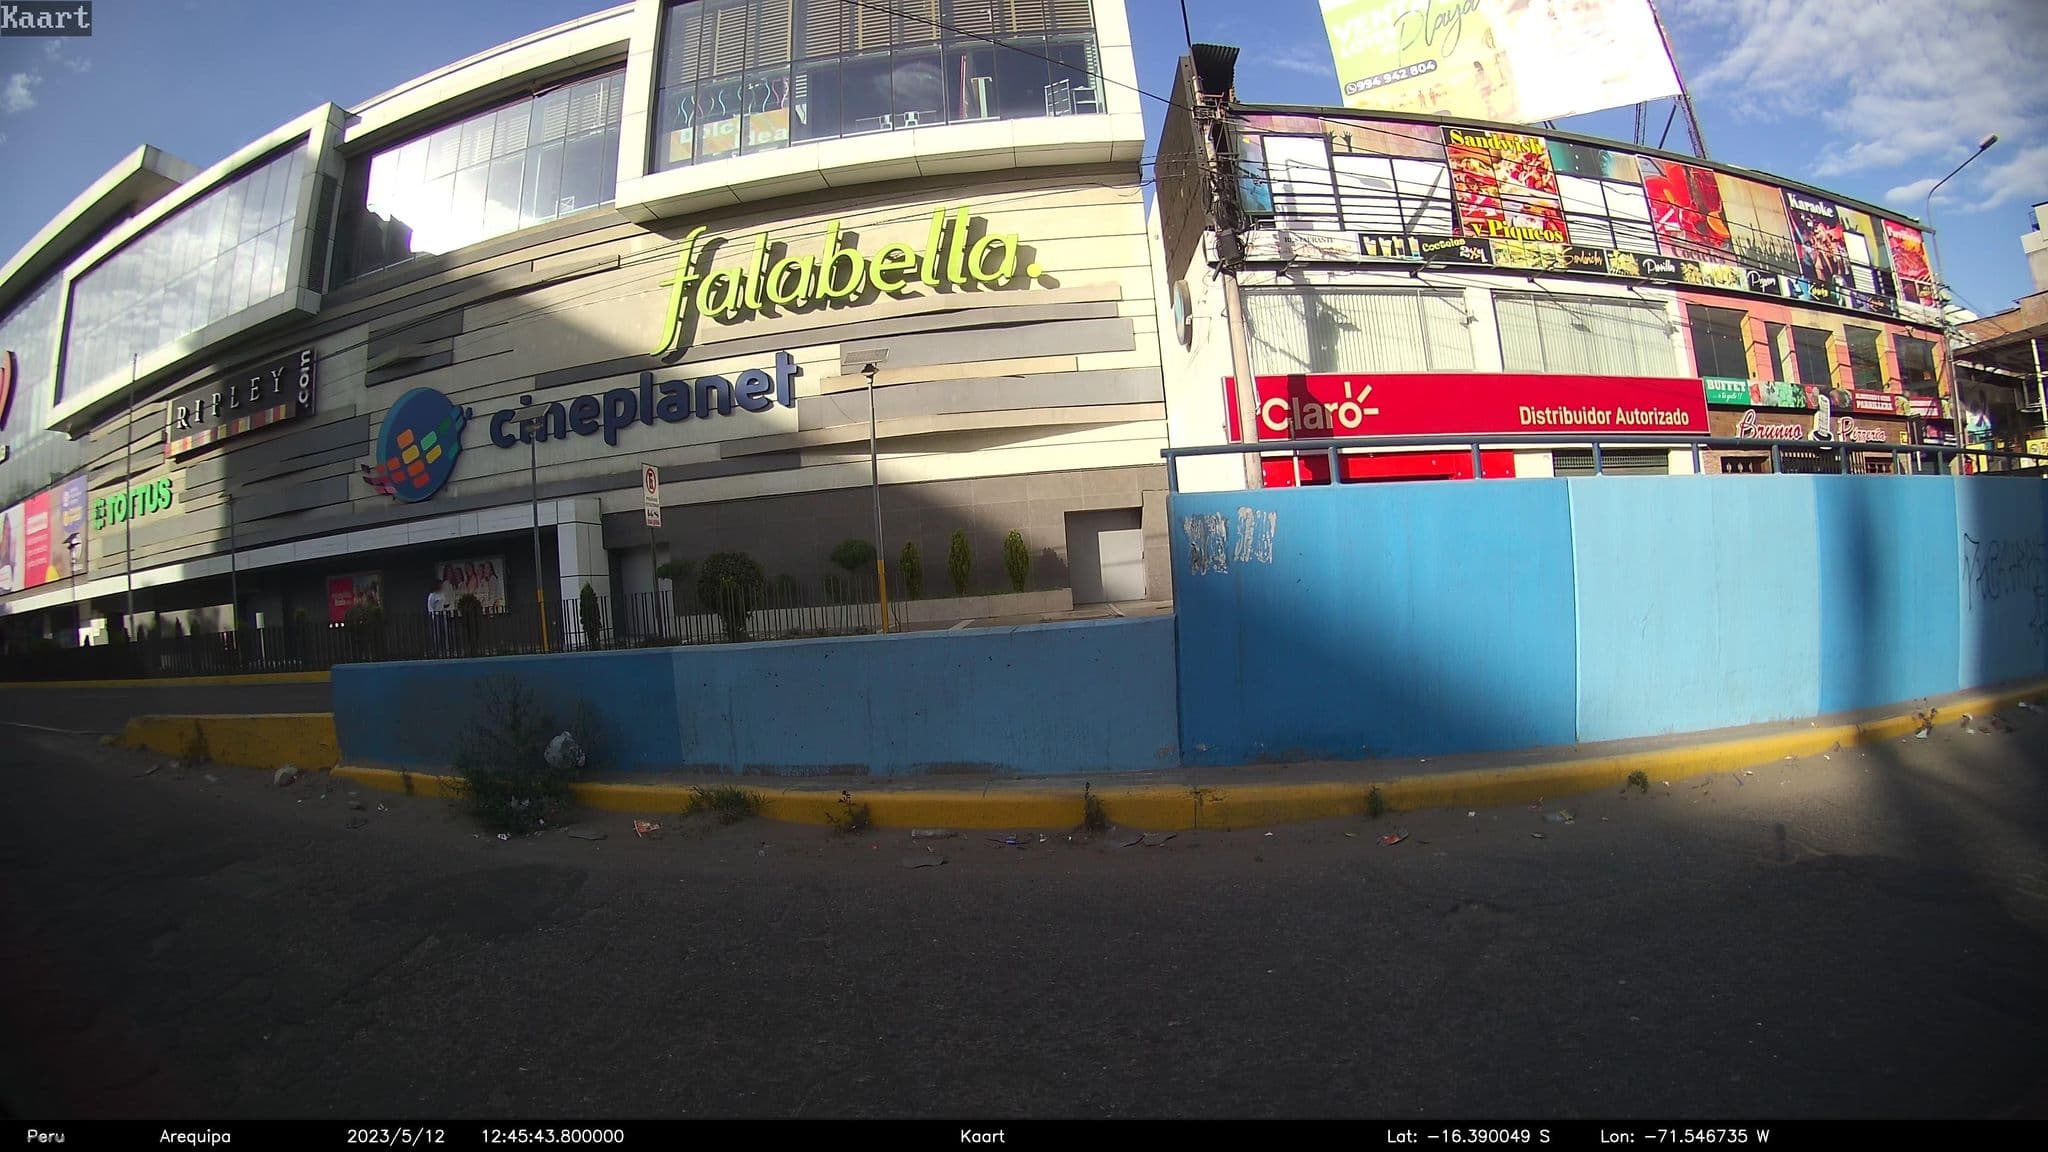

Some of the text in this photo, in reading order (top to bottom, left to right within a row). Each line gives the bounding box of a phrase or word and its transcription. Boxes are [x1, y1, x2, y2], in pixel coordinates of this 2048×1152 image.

[1356, 61, 1436, 92] 994 942 804
[1786, 192, 1835, 218] Karaoke
[1487, 218, 1564, 243] Piqueos
[176, 366, 286, 431] RIPLEY
[490, 350, 800, 448] cineplanet
[1706, 379, 1746, 393] BUFFET
[1262, 397, 1363, 432] Claro
[1519, 406, 1689, 426] Distribuidor Autorizado
[1736, 408, 1803, 440] Brunno
[109, 478, 173, 526] TOTTUS
